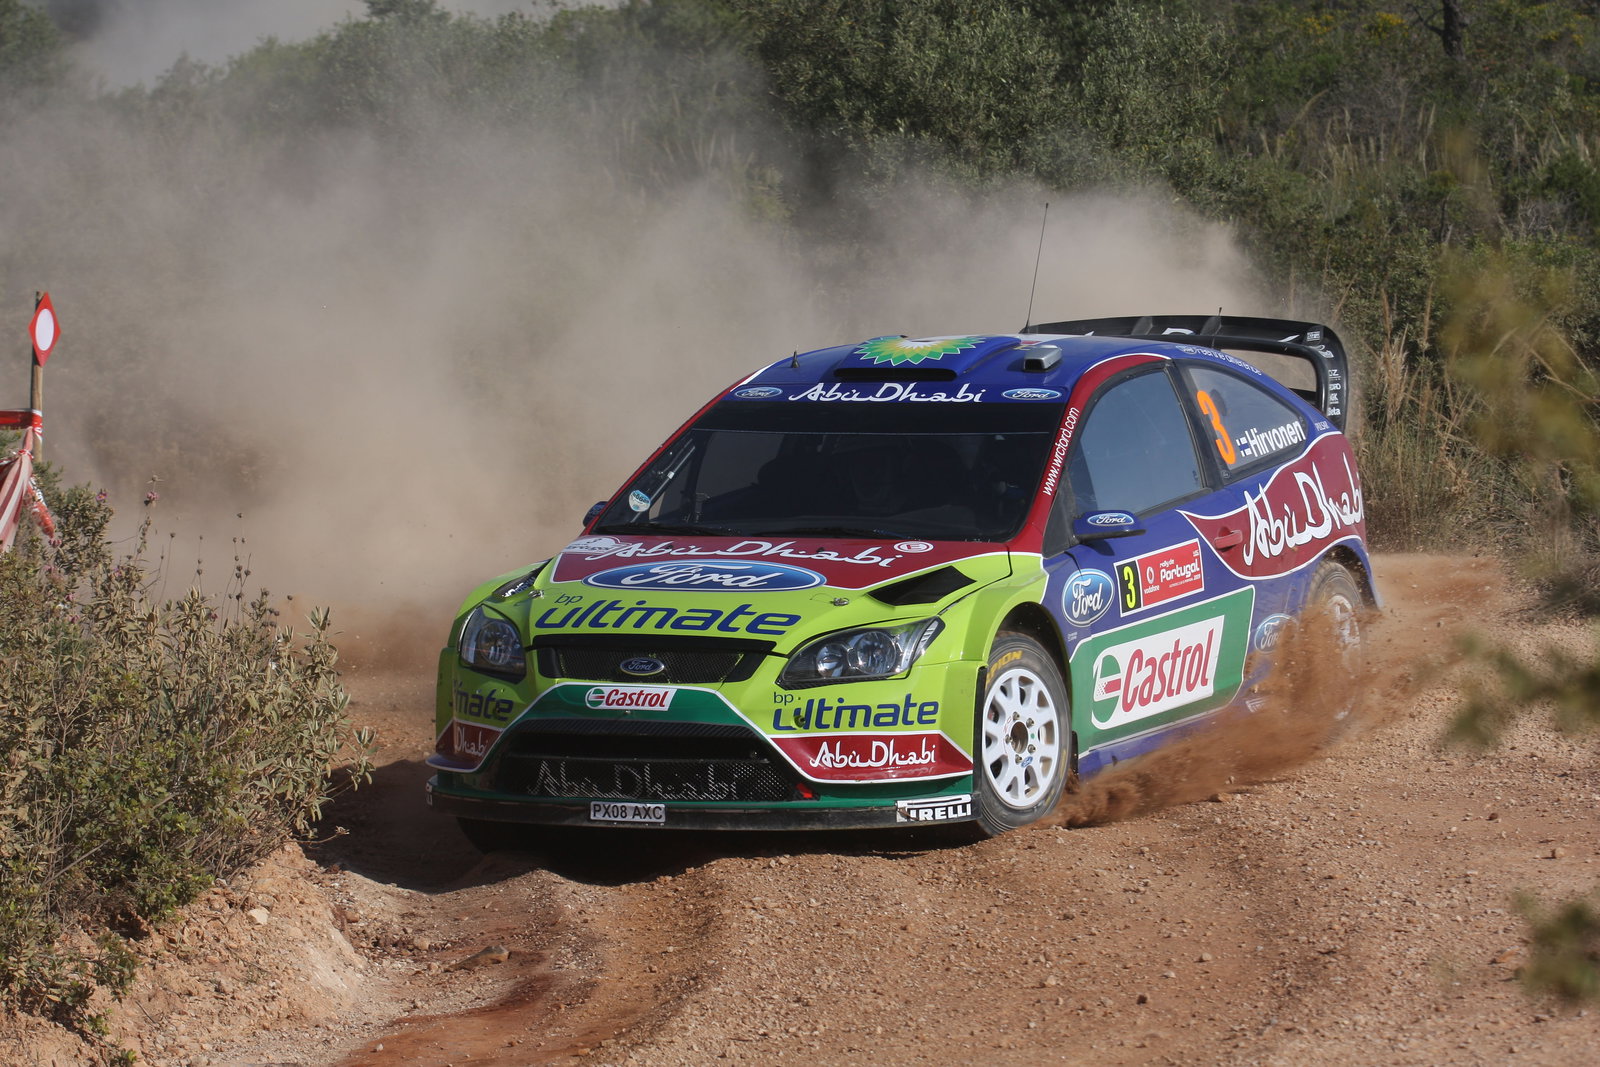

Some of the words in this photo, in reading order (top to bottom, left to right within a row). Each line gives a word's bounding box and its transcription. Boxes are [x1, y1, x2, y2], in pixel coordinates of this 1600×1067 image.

[742, 387, 776, 398] Ford
[1010, 387, 1050, 399] Ford
[1197, 390, 1236, 464] 3
[1245, 421, 1306, 457] Hirvonen
[1042, 406, 1080, 496] www.wrcford.com
[1096, 514, 1126, 525] Ford
[1243, 483, 1301, 566] Abu
[585, 541, 708, 561] Abu
[711, 541, 903, 568] Dhabi
[620, 564, 784, 588] Ford
[1160, 558, 1200, 582] Portugal
[554, 594, 583, 606] bp
[1071, 577, 1104, 619] Ford
[1123, 566, 1136, 609] 3
[535, 600, 802, 636] ultimate
[628, 660, 654, 671] Ford
[1121, 628, 1214, 713] Castrol
[605, 689, 669, 707] Castrol
[773, 691, 794, 707] bp
[773, 693, 939, 730] ultimate
[809, 741, 868, 769] Abu
[871, 737, 936, 768] Dhabi
[593, 803, 628, 819] PX08
[632, 804, 663, 820] AXC
